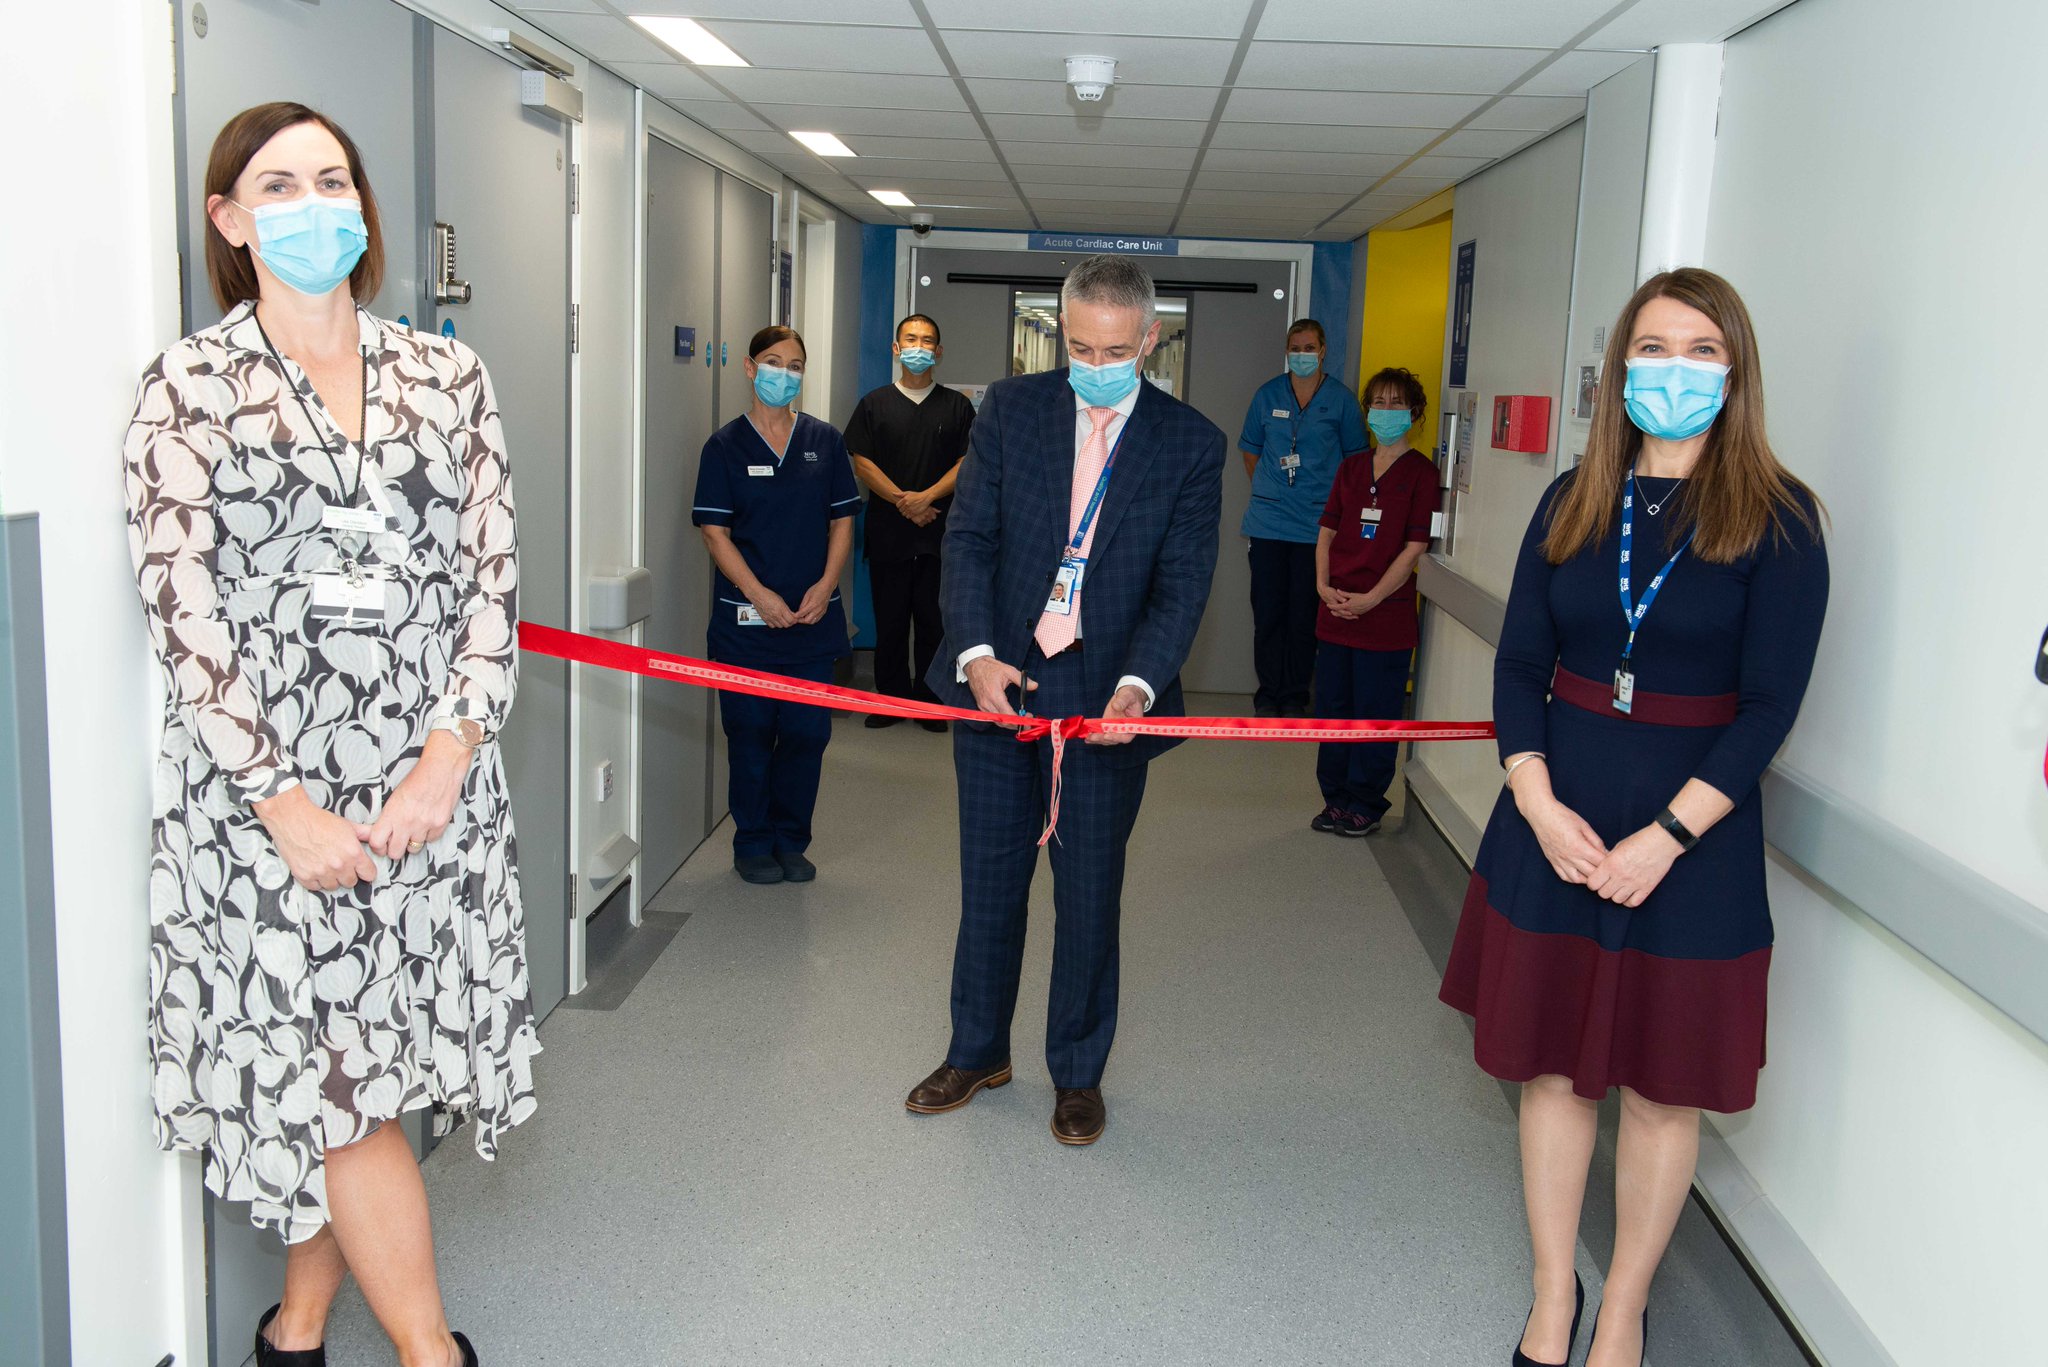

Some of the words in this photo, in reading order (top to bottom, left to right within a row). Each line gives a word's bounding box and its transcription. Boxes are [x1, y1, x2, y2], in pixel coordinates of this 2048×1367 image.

[1044, 237, 1073, 247] Acute
[1075, 238, 1114, 249] Cardiac
[1116, 239, 1140, 250] Care
[1142, 240, 1163, 251] Unit
[1634, 603, 1645, 618] NHS
